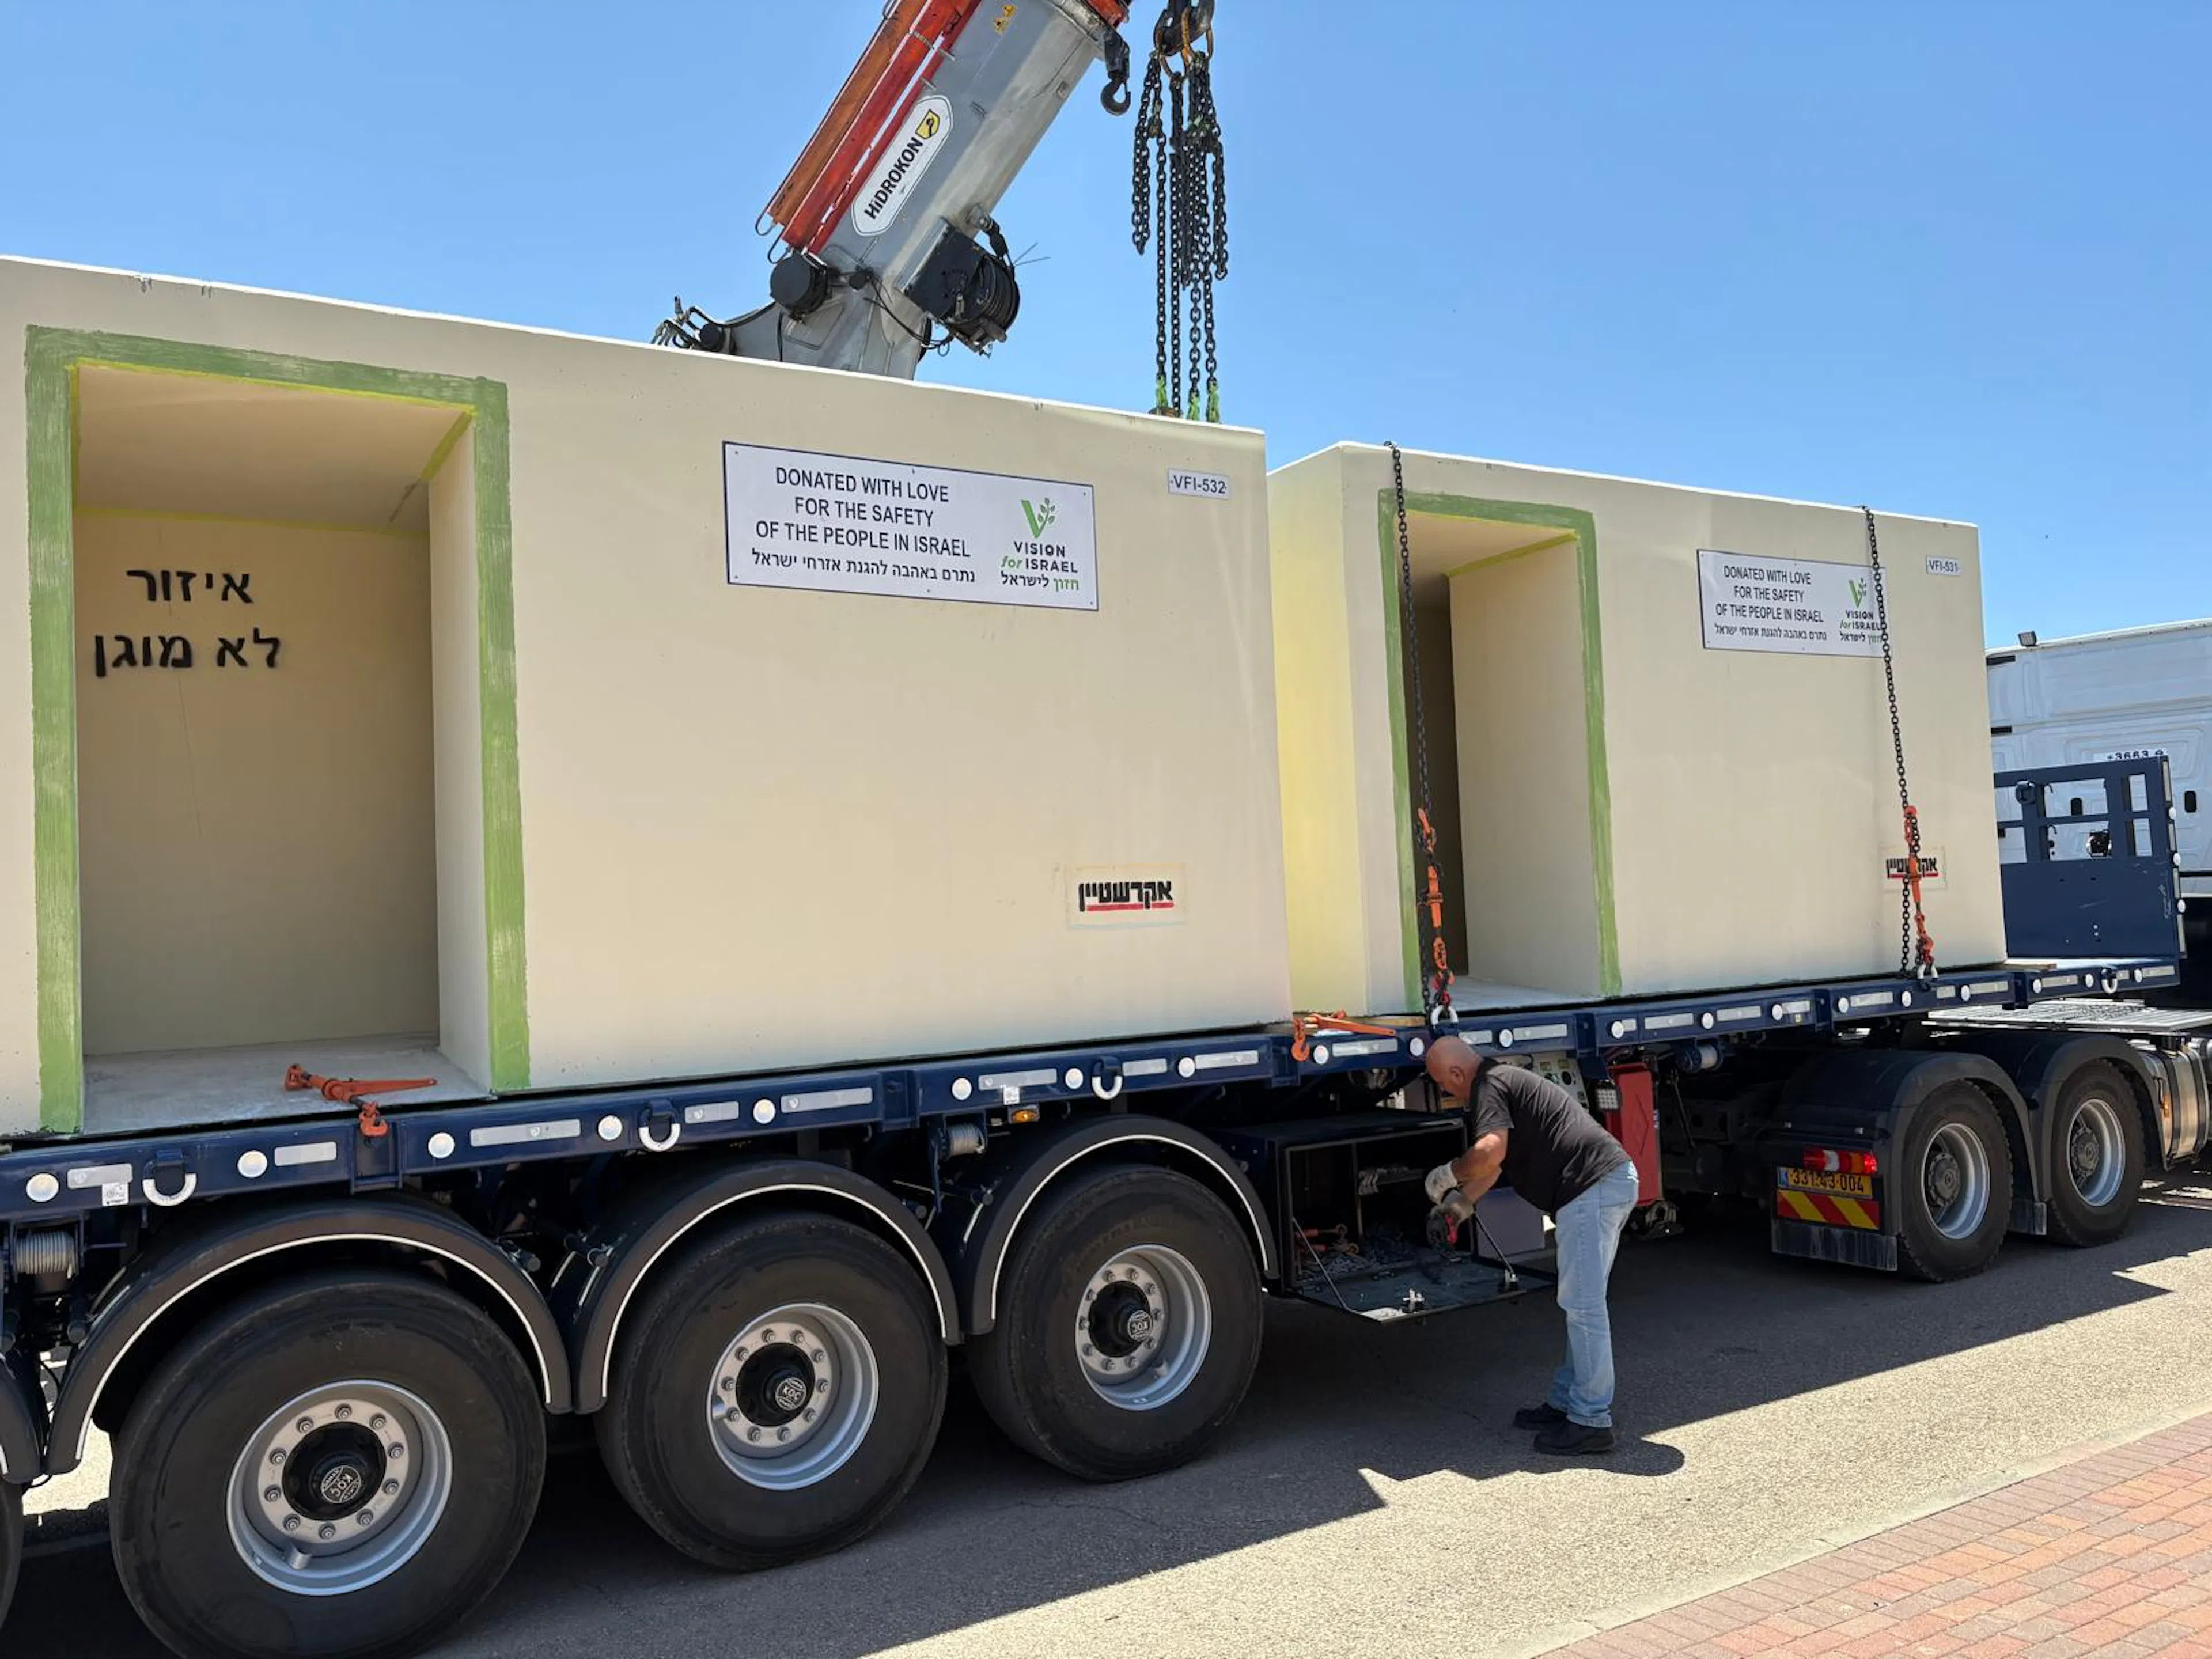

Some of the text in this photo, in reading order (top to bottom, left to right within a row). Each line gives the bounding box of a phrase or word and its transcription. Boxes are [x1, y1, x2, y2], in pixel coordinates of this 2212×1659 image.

[777, 467, 949, 502] DONATED WITH LOVE
[1173, 475, 1225, 494] VFI-532
[795, 496, 933, 527] FOR THE SAFETY
[756, 520, 970, 557] OF THE PEOPLE IN ISRAEL
[1014, 541, 1065, 557] VISION
[752, 548, 975, 582] נתרם באהבה להגנת אזרחי ישראל
[1001, 556, 1078, 573] for ISRAEL
[1001, 571, 1080, 592] חזון לישראל
[1724, 566, 1811, 585] DONATED WITH LOVE
[126, 570, 254, 604] איזור
[1734, 586, 1804, 603] FOR THE SAFETY
[1715, 604, 1824, 622] OF THE PEOPLE IN ISRAEL
[1845, 610, 1873, 619] VISION
[1853, 622, 1880, 631] ISRAEL
[94, 627, 281, 678] לא מוגן
